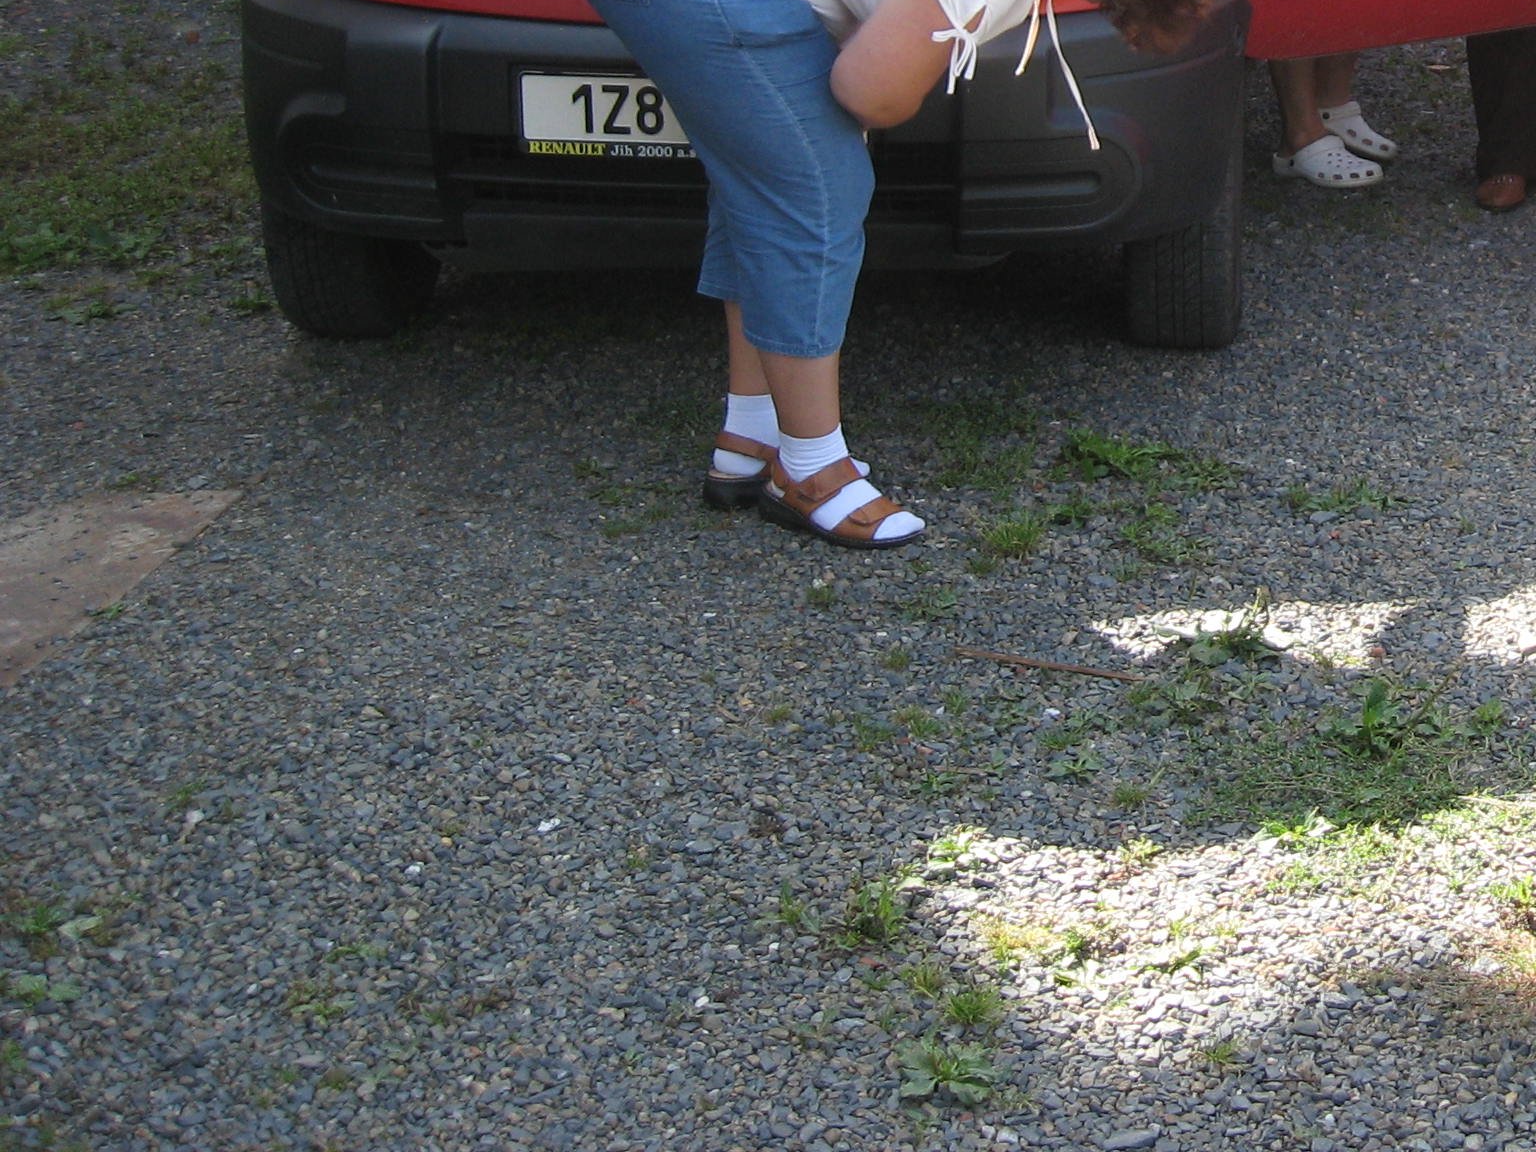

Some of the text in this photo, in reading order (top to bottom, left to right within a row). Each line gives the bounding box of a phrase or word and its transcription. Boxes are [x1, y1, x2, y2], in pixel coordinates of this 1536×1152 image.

[571, 83, 664, 135] 1Z8
[529, 141, 607, 156] RENAULT
[610, 144, 634, 157] Jih
[637, 145, 674, 158] 2000
